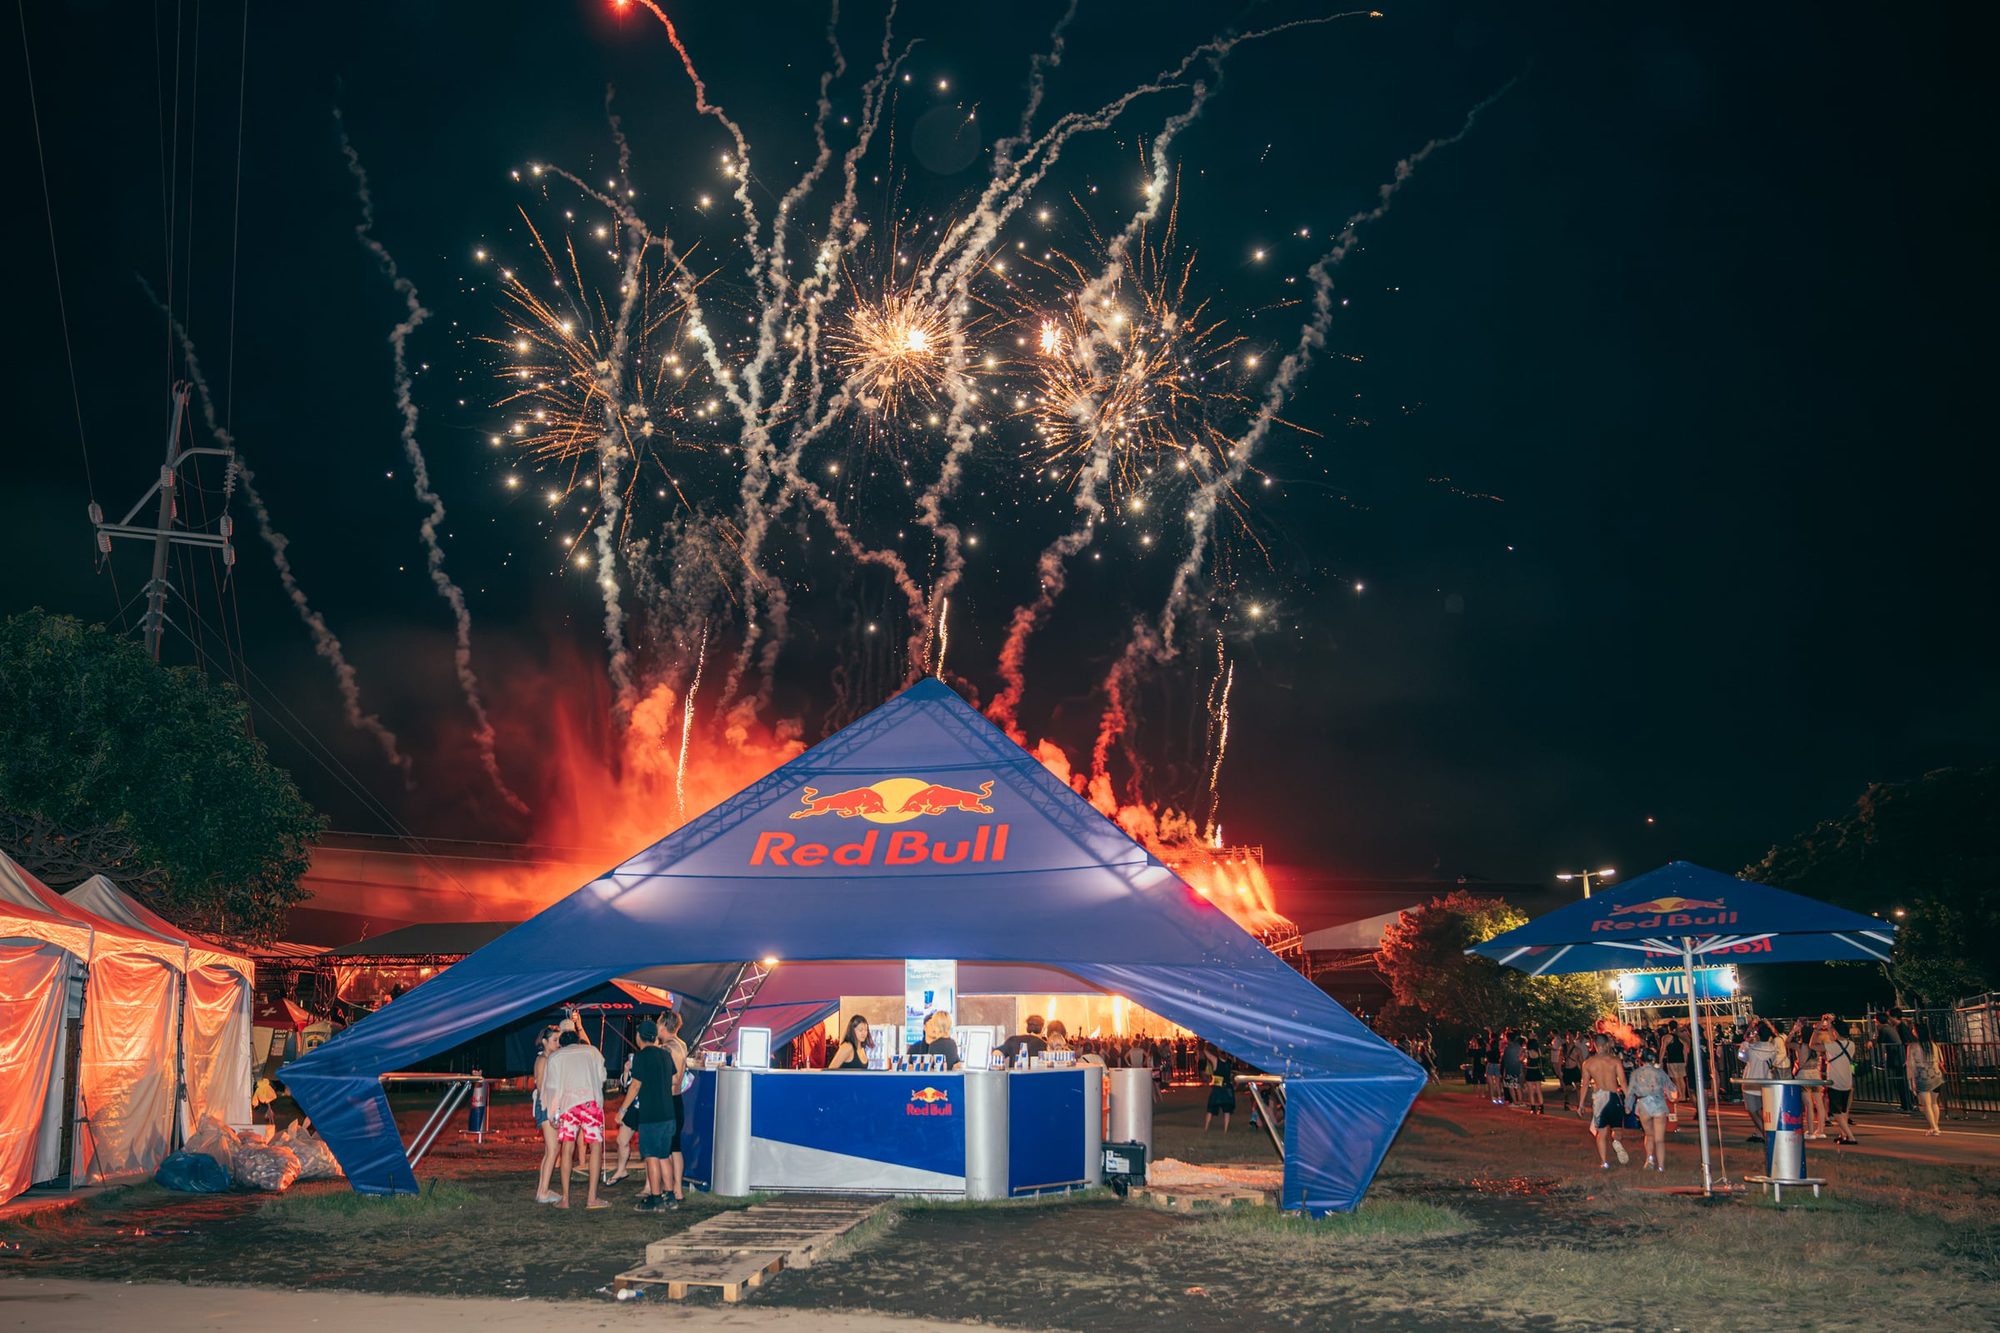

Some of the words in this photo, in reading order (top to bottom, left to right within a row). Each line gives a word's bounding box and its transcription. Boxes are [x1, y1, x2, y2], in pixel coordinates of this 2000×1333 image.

[749, 829, 879, 867] Red
[884, 823, 1009, 866] Bull
[1590, 914, 1662, 932] Red
[1667, 911, 1738, 927] Bull
[906, 1104, 928, 1116] Red
[930, 1104, 952, 1116] Bull
